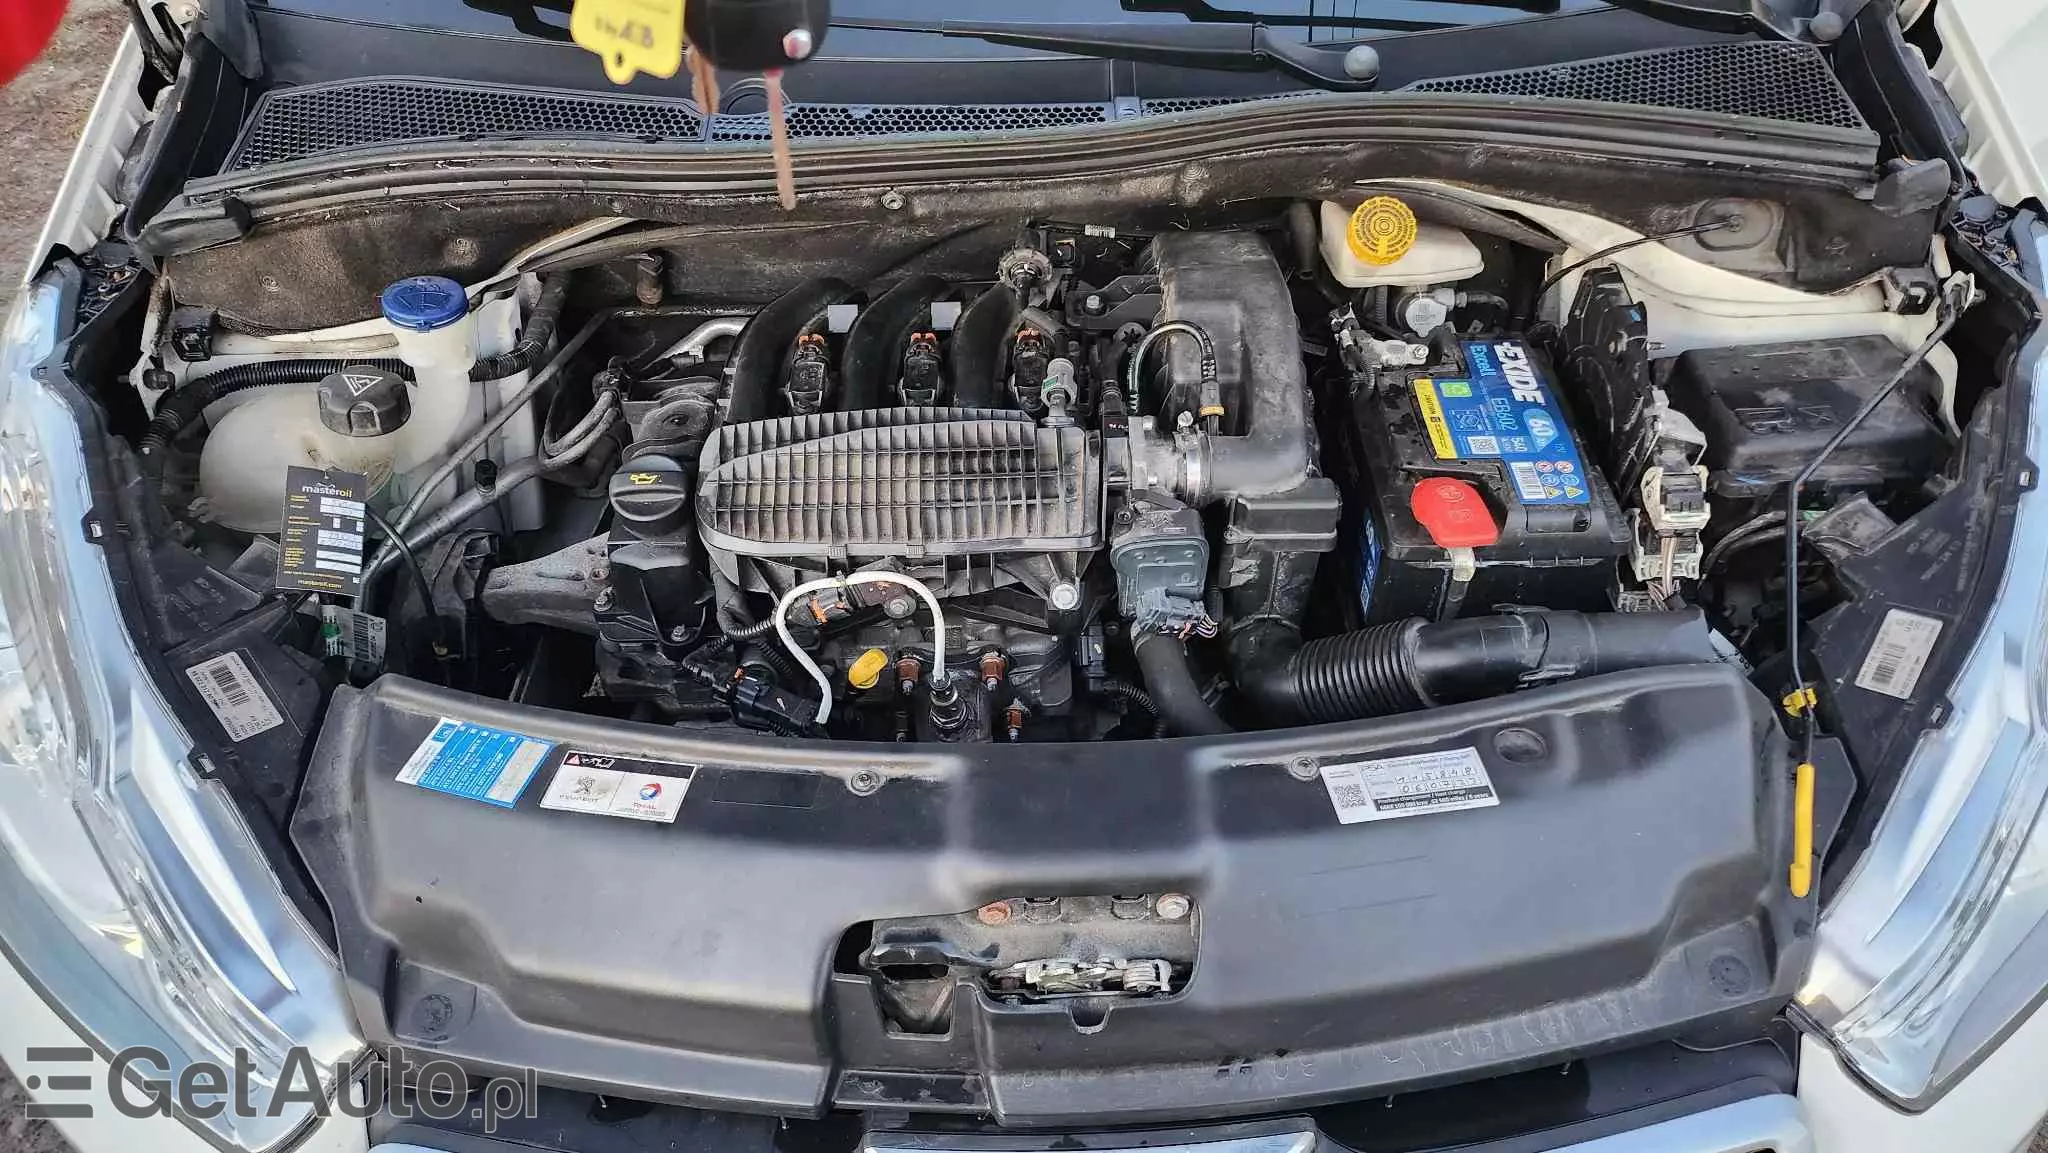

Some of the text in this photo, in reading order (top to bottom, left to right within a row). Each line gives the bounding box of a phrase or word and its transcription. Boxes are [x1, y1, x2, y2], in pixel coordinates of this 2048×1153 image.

[1470, 344, 1497, 377] Excell
[1494, 342, 1546, 406] EXIDE
[1491, 397, 1520, 432] EB602
[302, 485, 353, 499] masteroil
